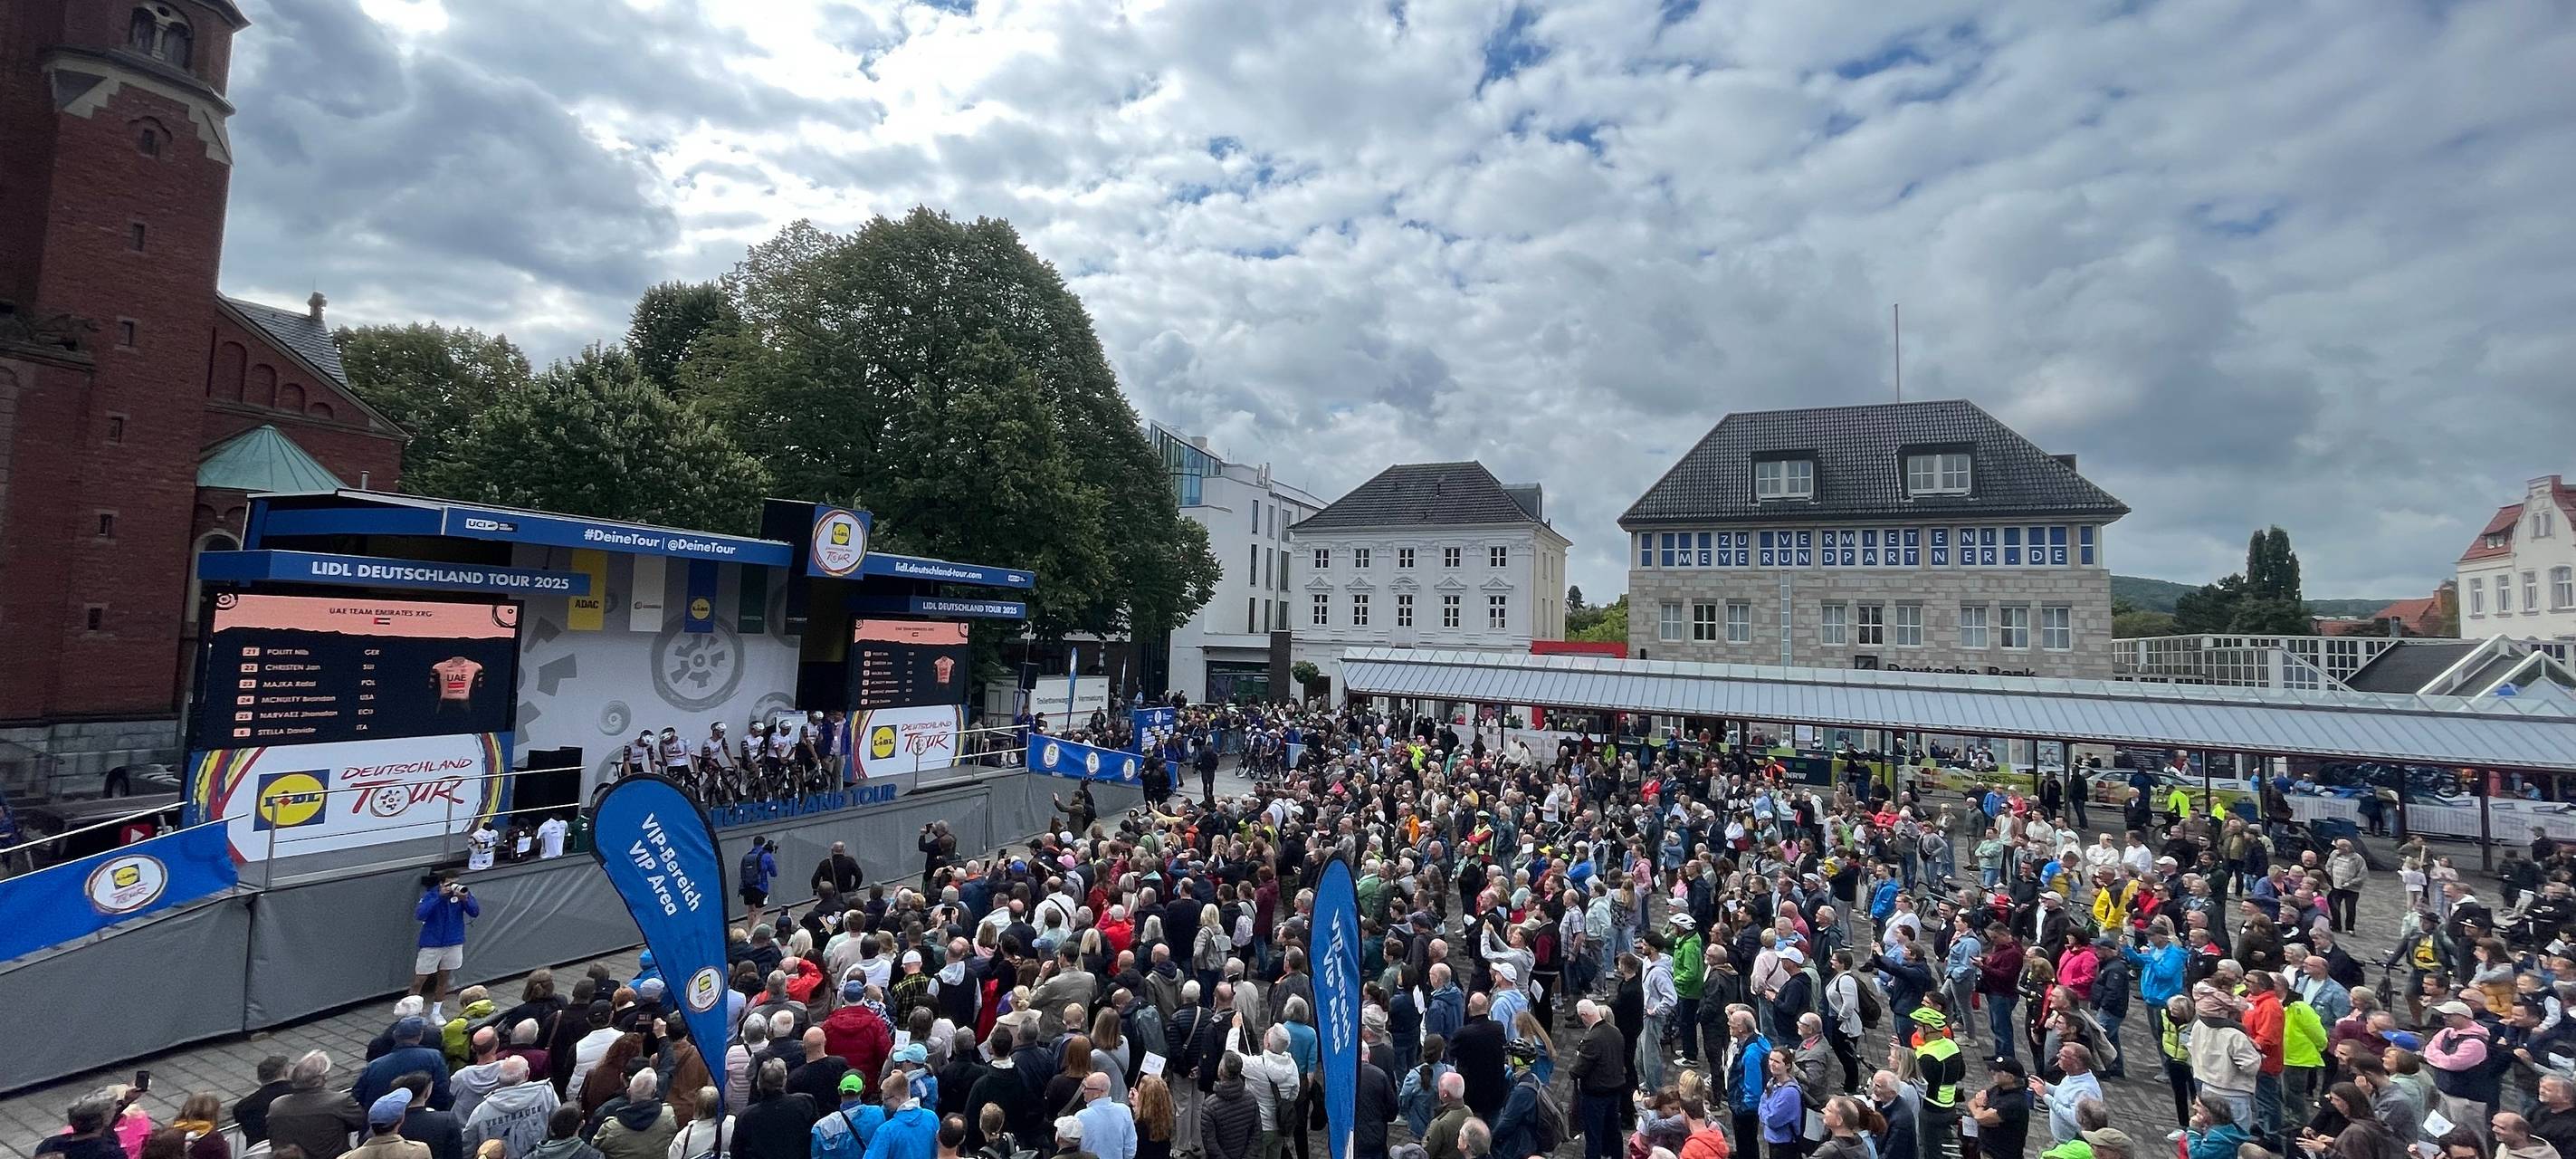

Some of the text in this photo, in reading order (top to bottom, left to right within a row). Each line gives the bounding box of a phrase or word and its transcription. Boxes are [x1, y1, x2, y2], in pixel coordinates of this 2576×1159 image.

[584, 529, 660, 548] #DeineTour
[668, 538, 736, 555] @DeineTour
[1721, 534, 1747, 545] ZU
[311, 561, 570, 590] LIDL DEUTSCHLAND TOUR 2025
[895, 561, 982, 580] lidl.deutschland-tour.com
[375, 608, 413, 617] EMIRATES
[575, 599, 599, 609] ADAC
[922, 601, 1017, 614] LIDL DEUTSCHLAND TOUR 2025
[904, 732, 949, 755] TOUR
[340, 756, 473, 781] DEUTSCHLAND
[348, 776, 464, 817] TOUR
[851, 783, 897, 808] TOUR
[640, 812, 701, 913] VIP-Bereich
[628, 839, 677, 917] VIP Area
[1323, 945, 1340, 1055] VIP Area
